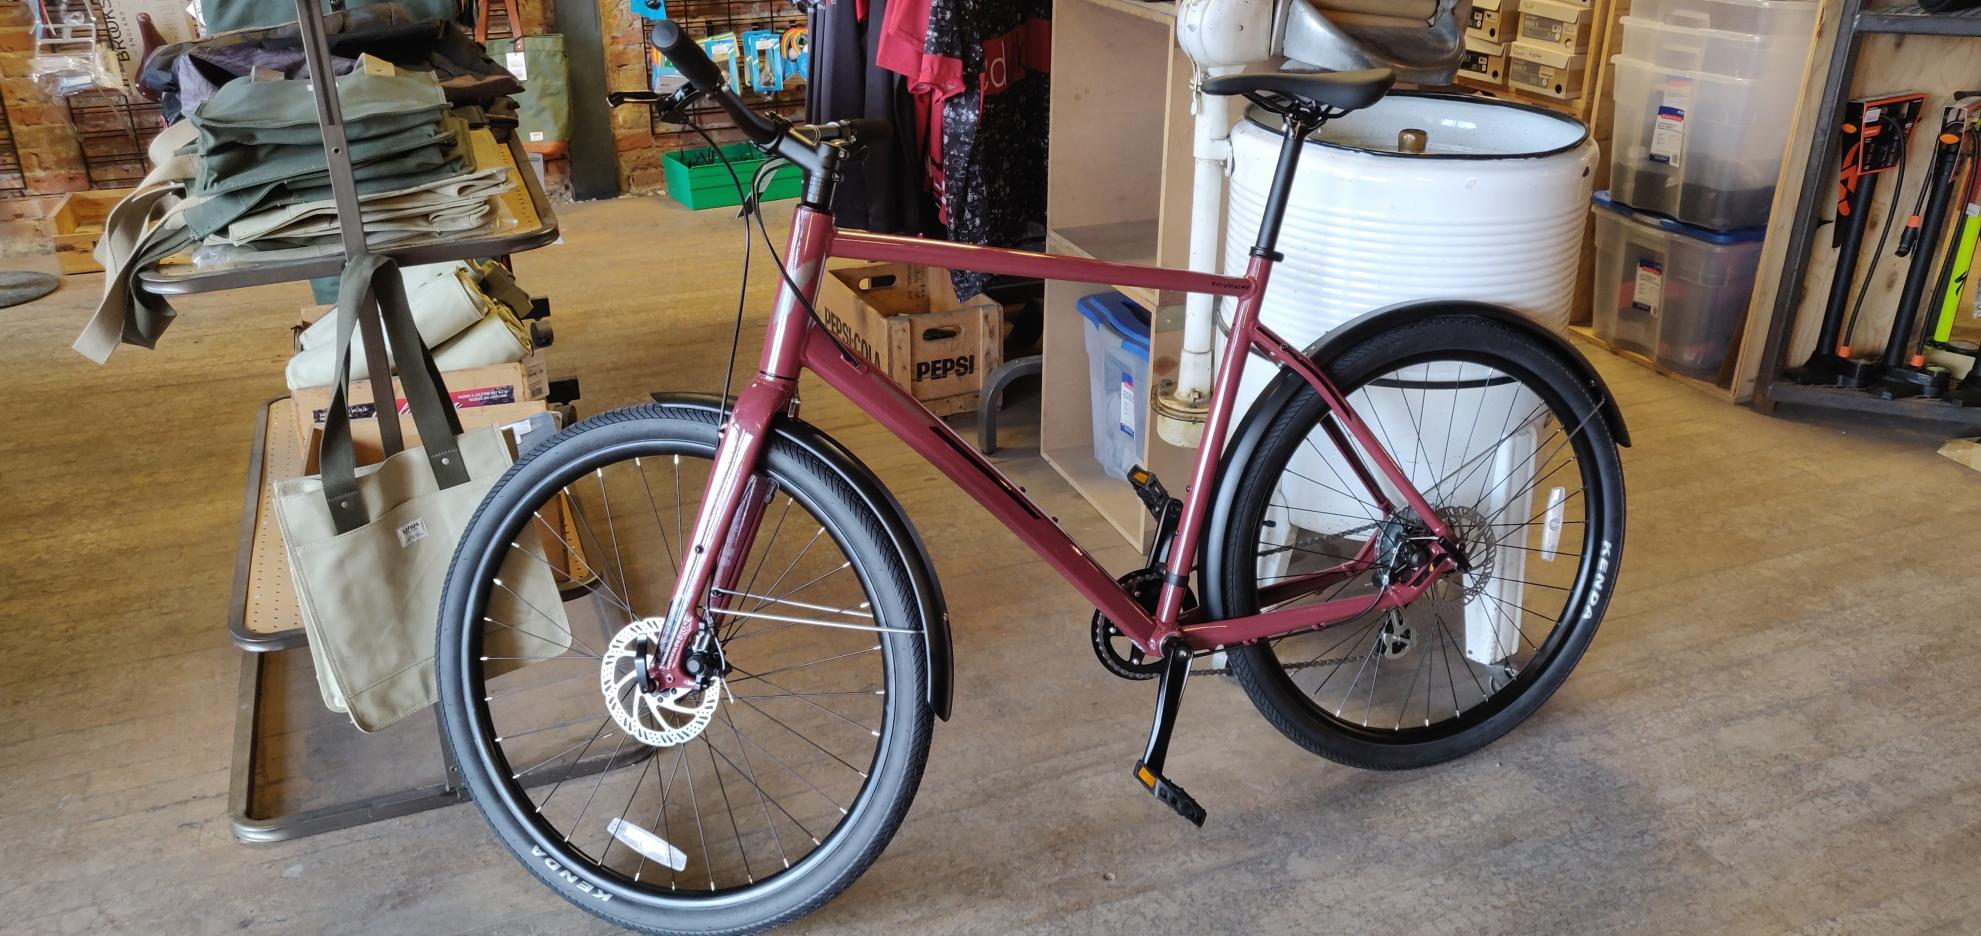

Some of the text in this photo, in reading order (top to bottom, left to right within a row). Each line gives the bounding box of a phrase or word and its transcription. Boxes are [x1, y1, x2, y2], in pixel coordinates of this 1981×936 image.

[916, 355, 975, 383] PEPSI
[1583, 540, 1612, 619] KENDA
[531, 844, 614, 902] KENDA
